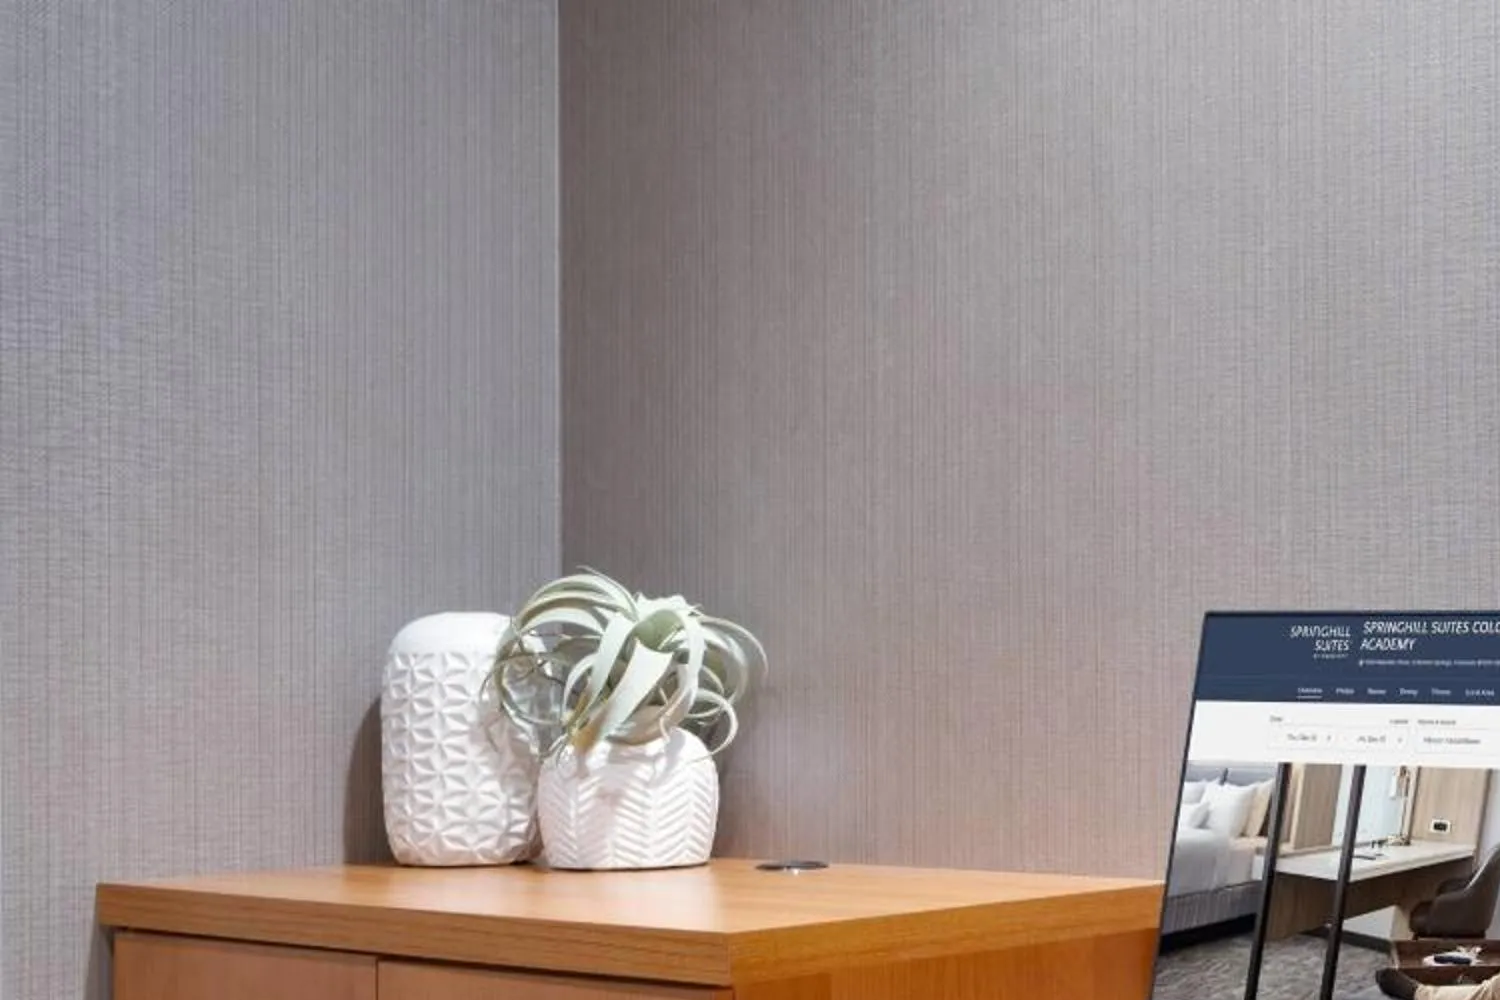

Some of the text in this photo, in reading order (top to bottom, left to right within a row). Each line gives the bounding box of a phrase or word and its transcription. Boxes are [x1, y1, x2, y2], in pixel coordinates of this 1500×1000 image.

[1289, 625, 1351, 639] SPRINGHILL
[1363, 620, 1429, 635] SPRINGHILL
[1431, 620, 1469, 635] SUITES
[1313, 638, 1351, 652] SUITES
[1359, 637, 1417, 651] ACADEMY
